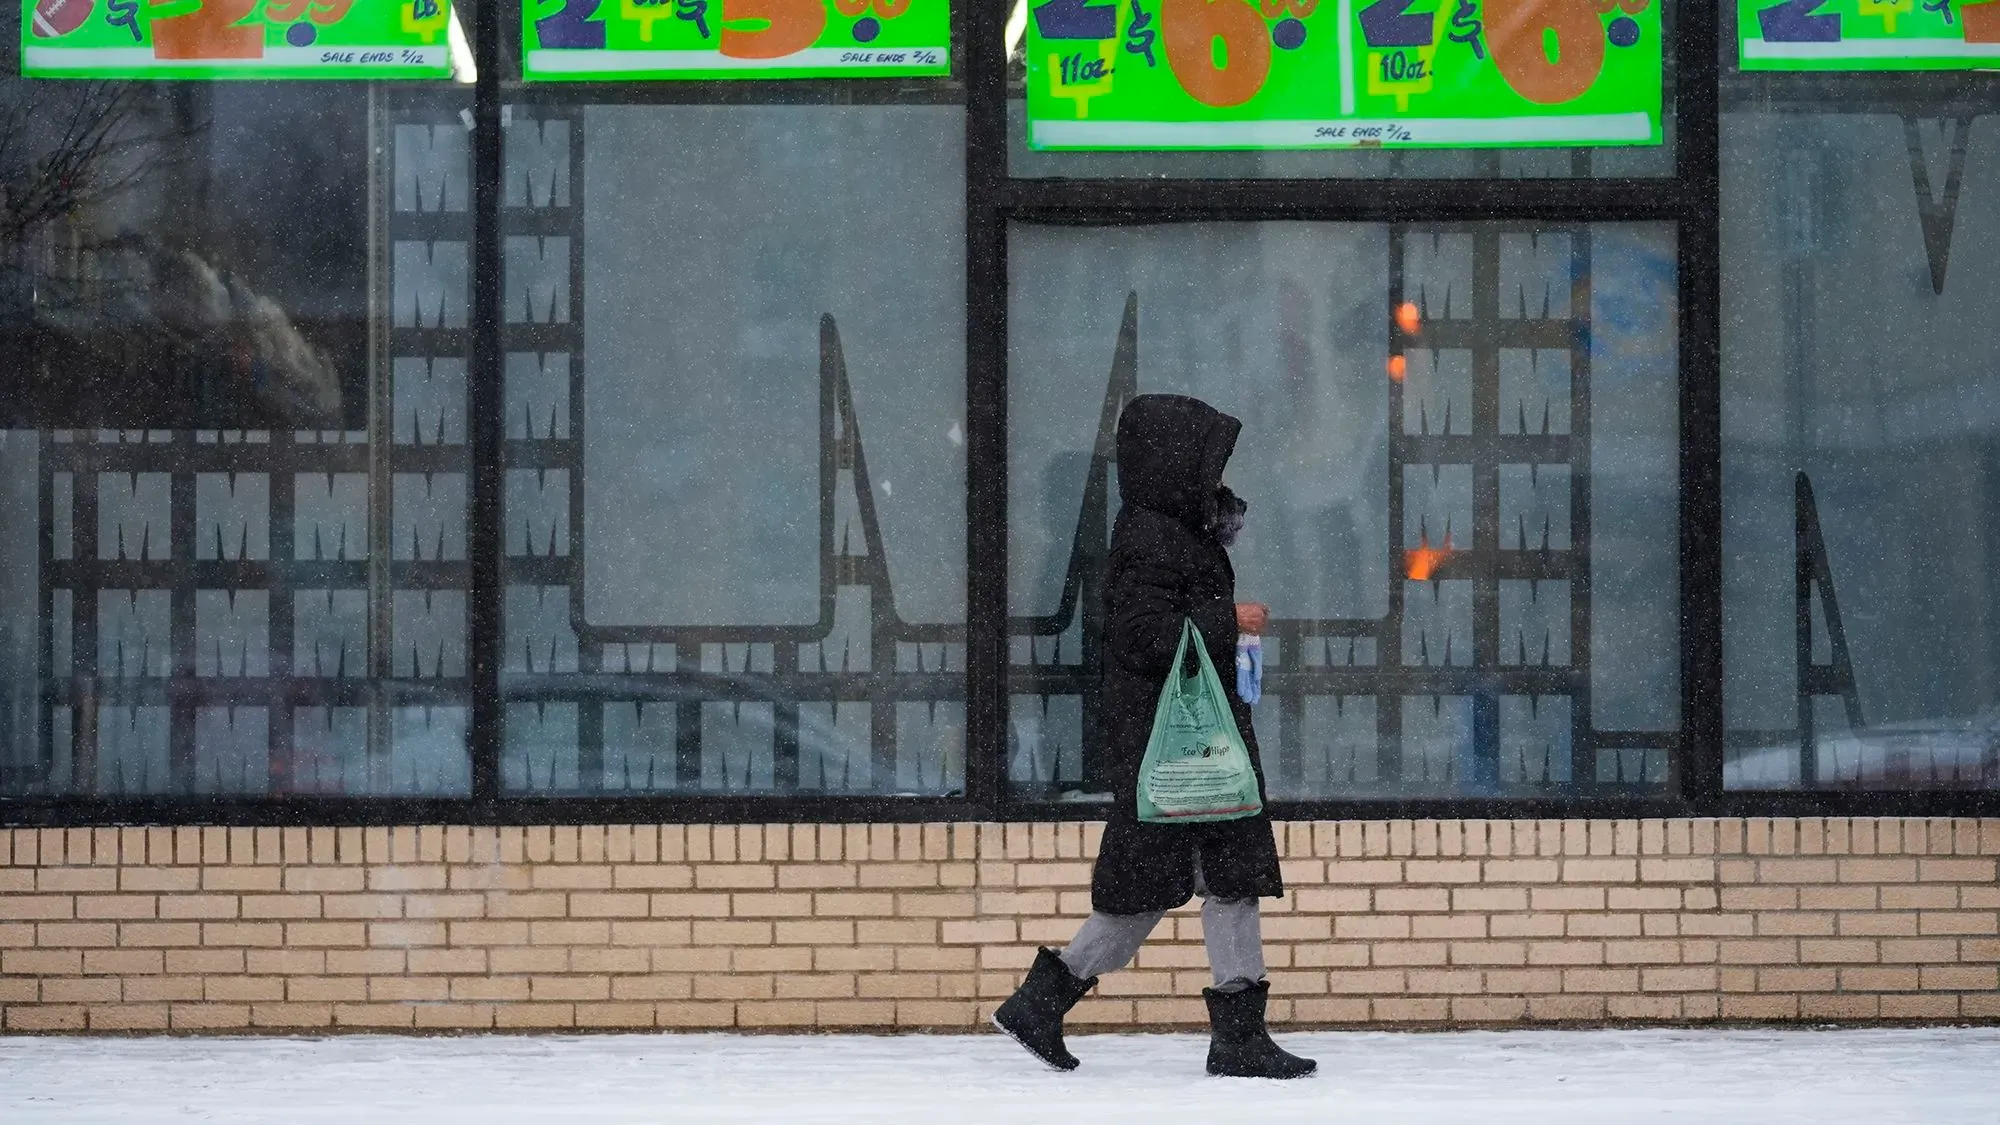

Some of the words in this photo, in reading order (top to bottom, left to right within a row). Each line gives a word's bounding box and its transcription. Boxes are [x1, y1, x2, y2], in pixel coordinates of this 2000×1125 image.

[320, 51, 356, 63] SALE
[359, 51, 395, 63] ENDS
[840, 52, 873, 63] SALE
[876, 52, 907, 63] ENDS
[913, 50, 937, 64] 2/12
[1060, 52, 1116, 86] 11oz.
[1380, 50, 1434, 82] 10oz.
[1314, 126, 1346, 138] SALE
[1351, 127, 1383, 138] ENDS
